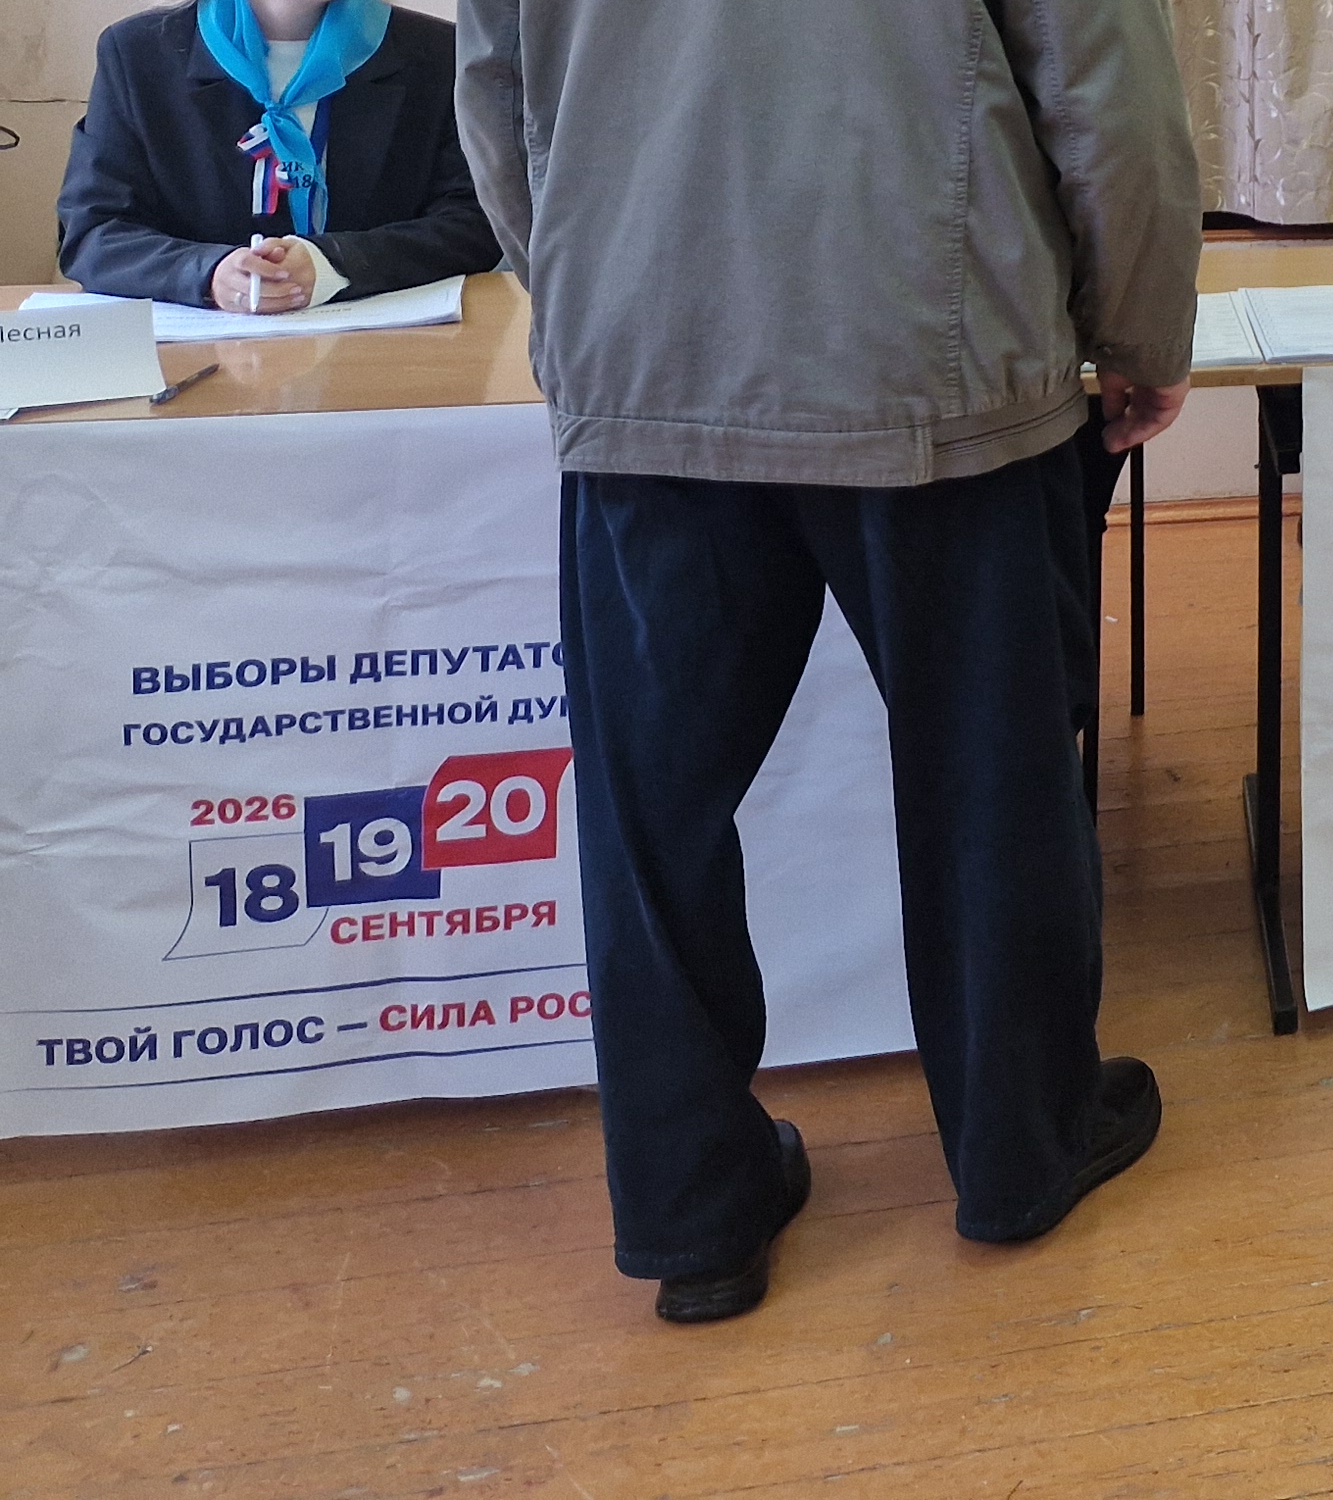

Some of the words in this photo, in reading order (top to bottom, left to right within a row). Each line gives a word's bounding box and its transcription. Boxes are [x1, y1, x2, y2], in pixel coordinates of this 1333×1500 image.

[281, 161, 304, 172] ИК
[291, 174, 312, 189] 18
[132, 654, 337, 696] ВЫБОРЫ
[350, 641, 565, 685] ДЕПУТАТ
[123, 694, 499, 747] ГОСУДАРСТВЕННОЙ
[507, 694, 568, 723] ДУ
[190, 794, 297, 827] 2026
[204, 863, 300, 928] 18
[319, 817, 413, 883] 19
[435, 774, 547, 842] 20
[329, 900, 557, 945] СЕНТЯБРЯ
[36, 1026, 159, 1067] ТВОЙ
[172, 1015, 326, 1059] ГОЛОС
[379, 1001, 496, 1033] СИЛА
